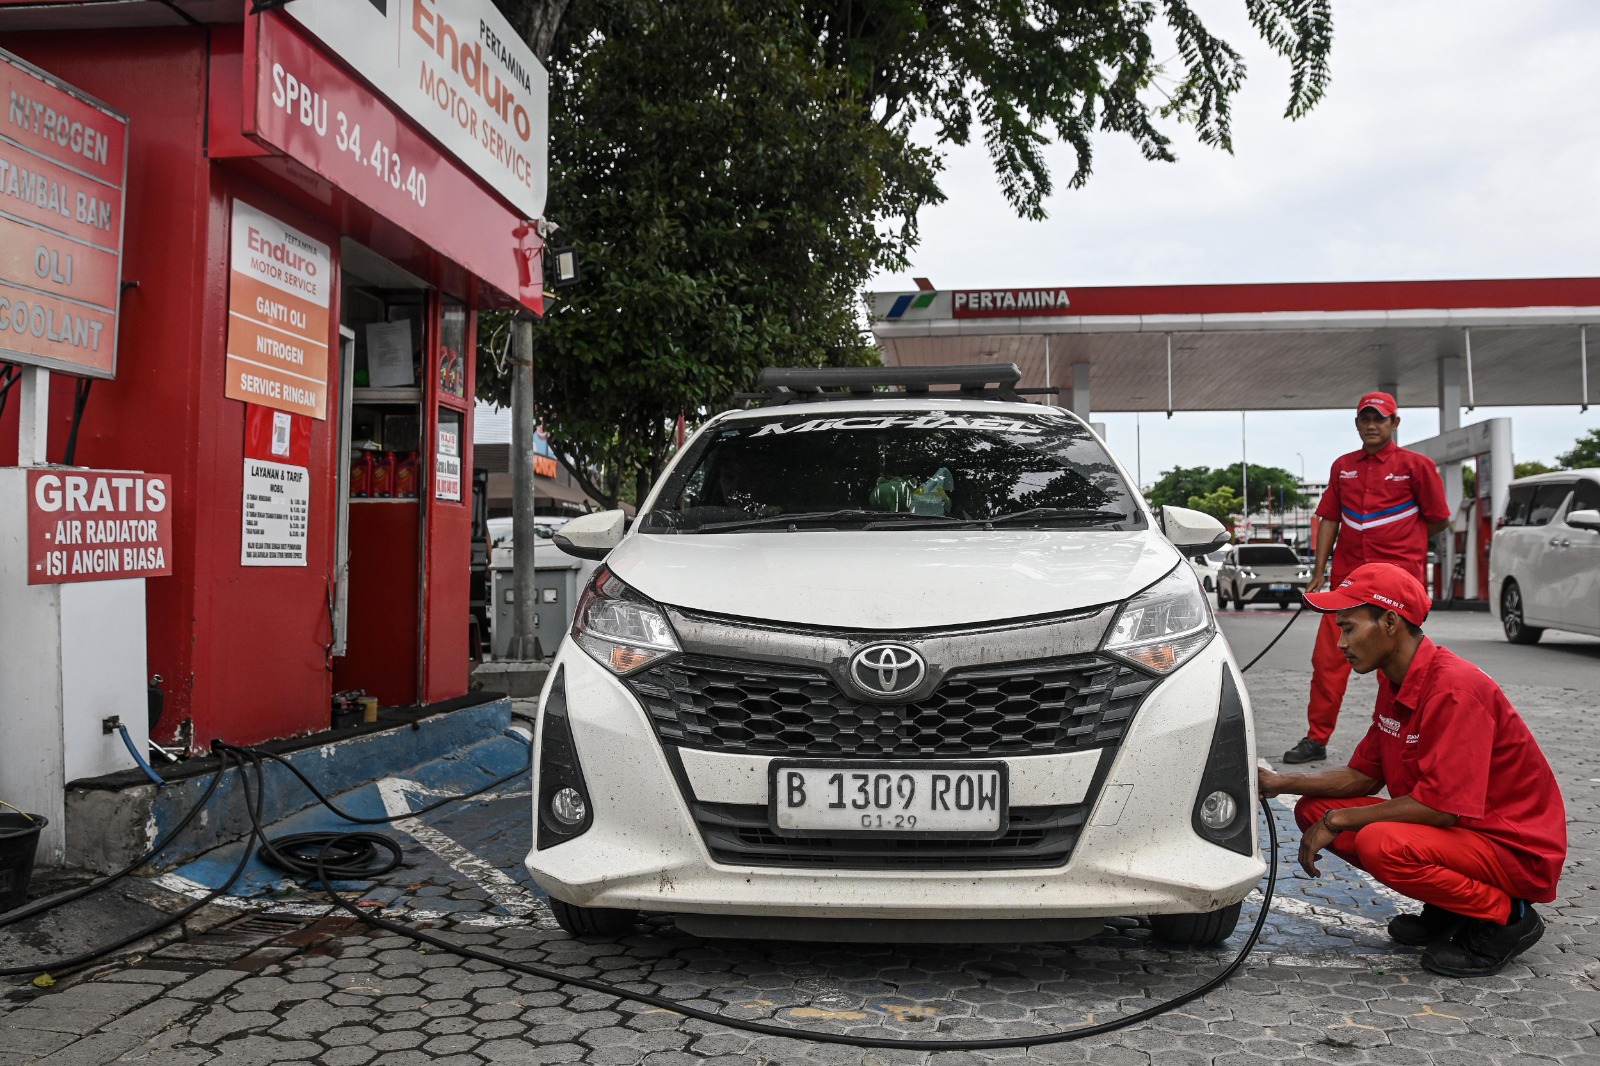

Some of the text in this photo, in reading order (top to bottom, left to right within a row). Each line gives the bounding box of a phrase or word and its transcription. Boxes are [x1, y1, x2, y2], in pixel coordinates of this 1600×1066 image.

[412, 0, 531, 142] Enduro
[480, 18, 531, 95] PERTAMINA
[9, 89, 108, 166] NITROGEN
[272, 63, 427, 207] SPBU 34.413.40
[420, 60, 531, 188] MOTOR SERVICE
[0, 158, 111, 232] TAMBAL BAN
[247, 226, 317, 277] Enduro
[284, 232, 317, 256] PERTAMINA
[34, 245, 73, 286] OLI
[250, 257, 317, 295] MOTOR SERVICE
[256, 296, 306, 329] GANTI OLI
[955, 290, 1070, 309] PERTAMINA
[0, 296, 104, 351] COOLANT
[256, 335, 304, 365] NITROGEN
[240, 373, 316, 407] SERVICE RINGAN
[35, 475, 166, 512] GRATIS
[251, 465, 303, 483] LAYANAN & TARIF
[55, 519, 158, 545] AIR RADIATOR
[46, 546, 165, 576] ISI ANGIN BIASA
[787, 771, 997, 811] B 1309 ROW
